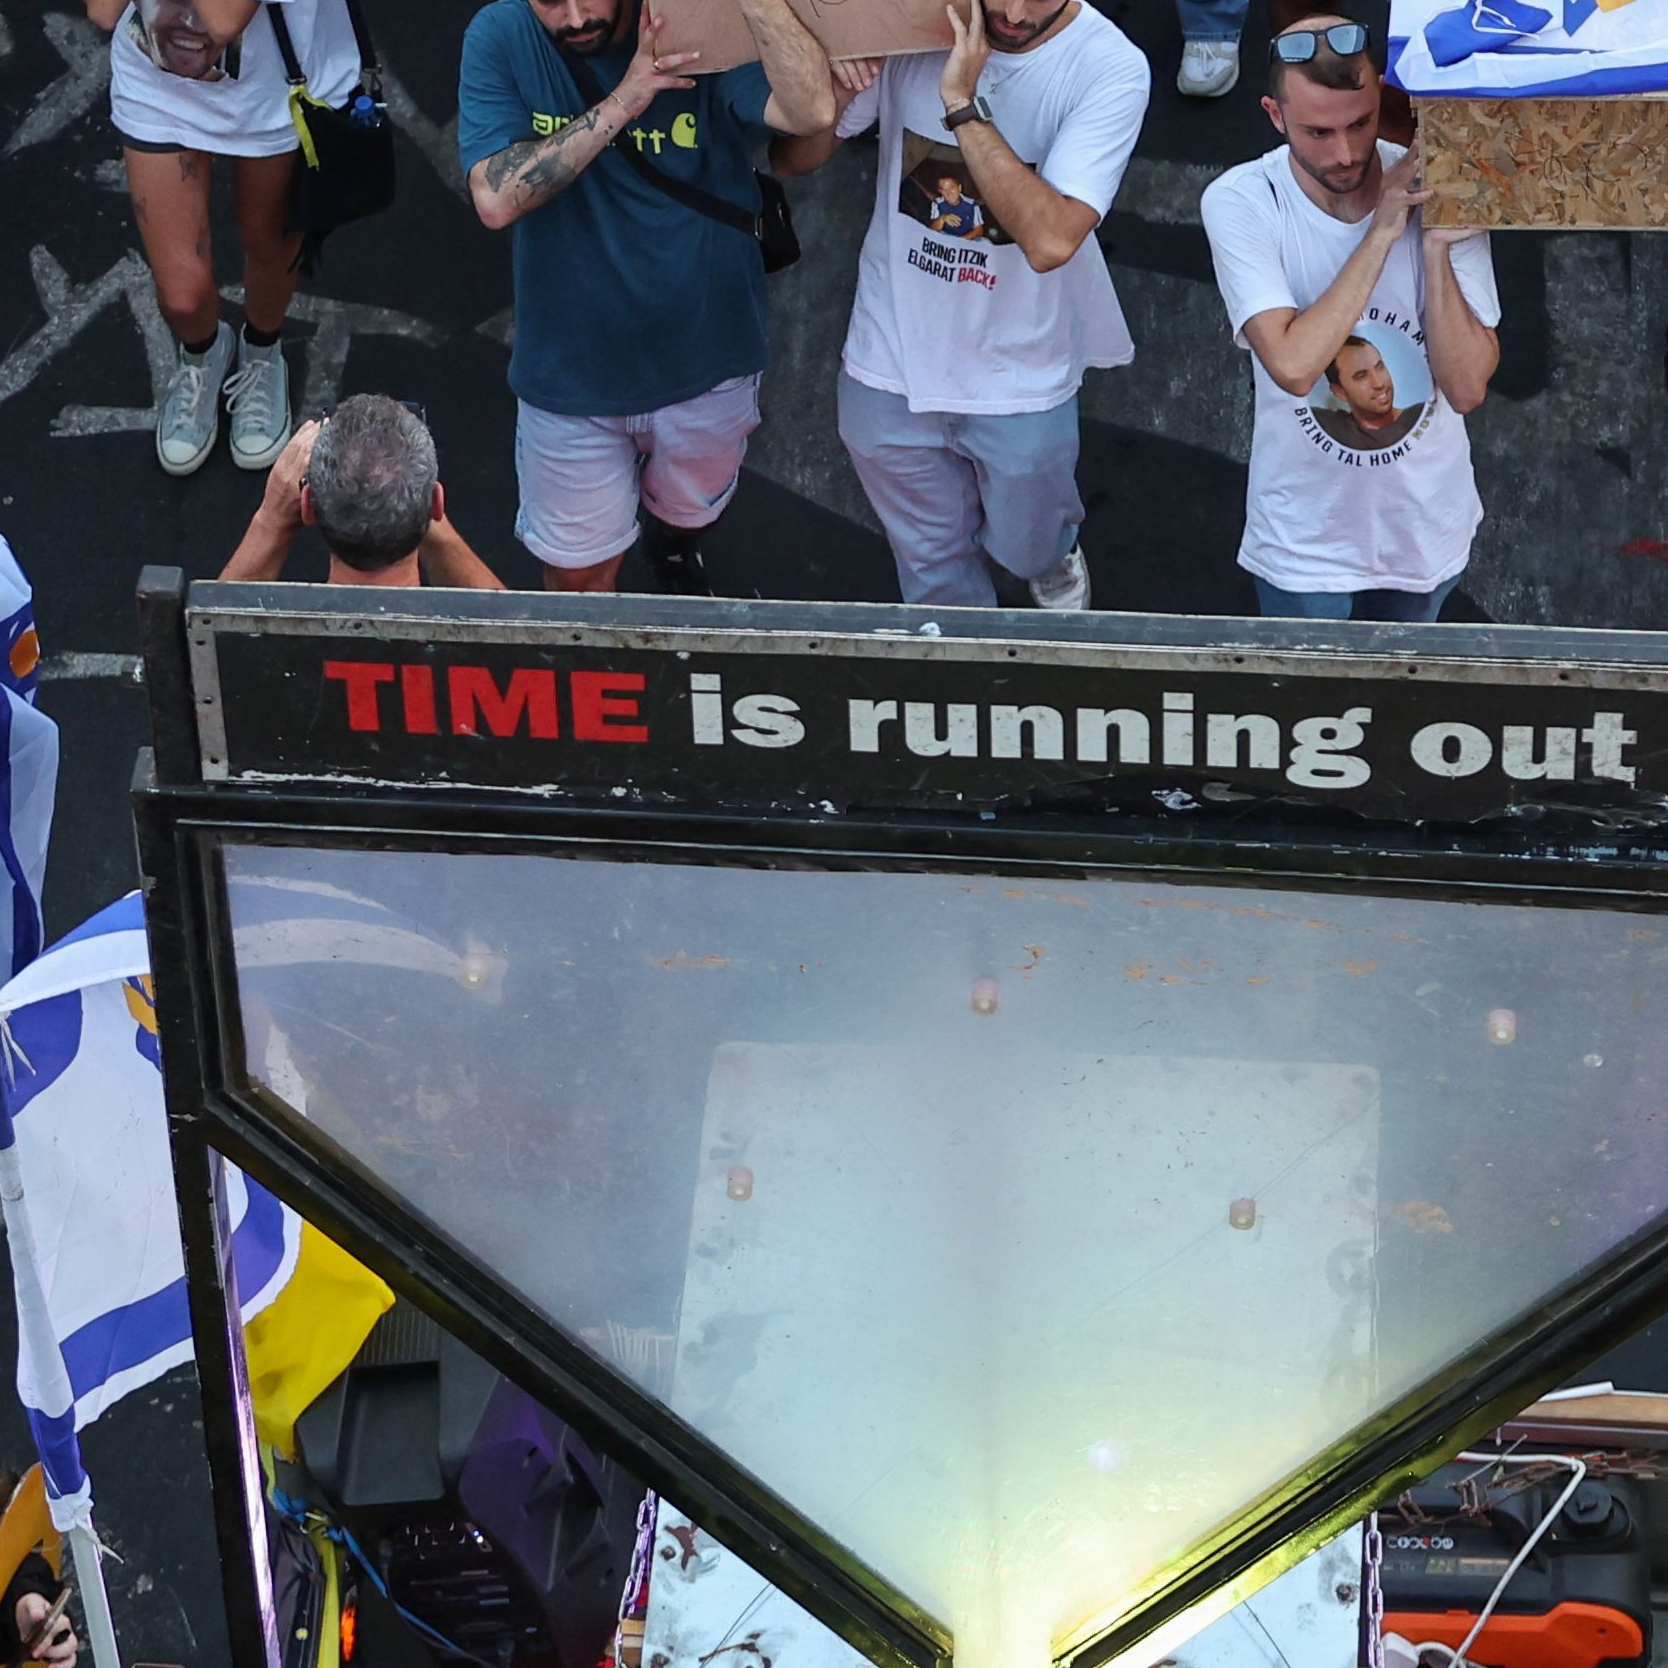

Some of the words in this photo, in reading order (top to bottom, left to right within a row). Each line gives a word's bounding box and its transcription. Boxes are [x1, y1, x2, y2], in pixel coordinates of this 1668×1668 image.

[907, 248, 956, 283] ELGARAT
[957, 267, 997, 291] BACK!
[922, 236, 956, 264] BRING
[957, 248, 988, 269] ITZIK
[1295, 406, 1332, 453] BRING
[1337, 448, 1362, 468] TAL
[1370, 440, 1412, 467] HOME
[324, 660, 649, 743] TIME
[691, 673, 805, 748] is
[848, 692, 1372, 789] running
[1411, 712, 1637, 783] out
